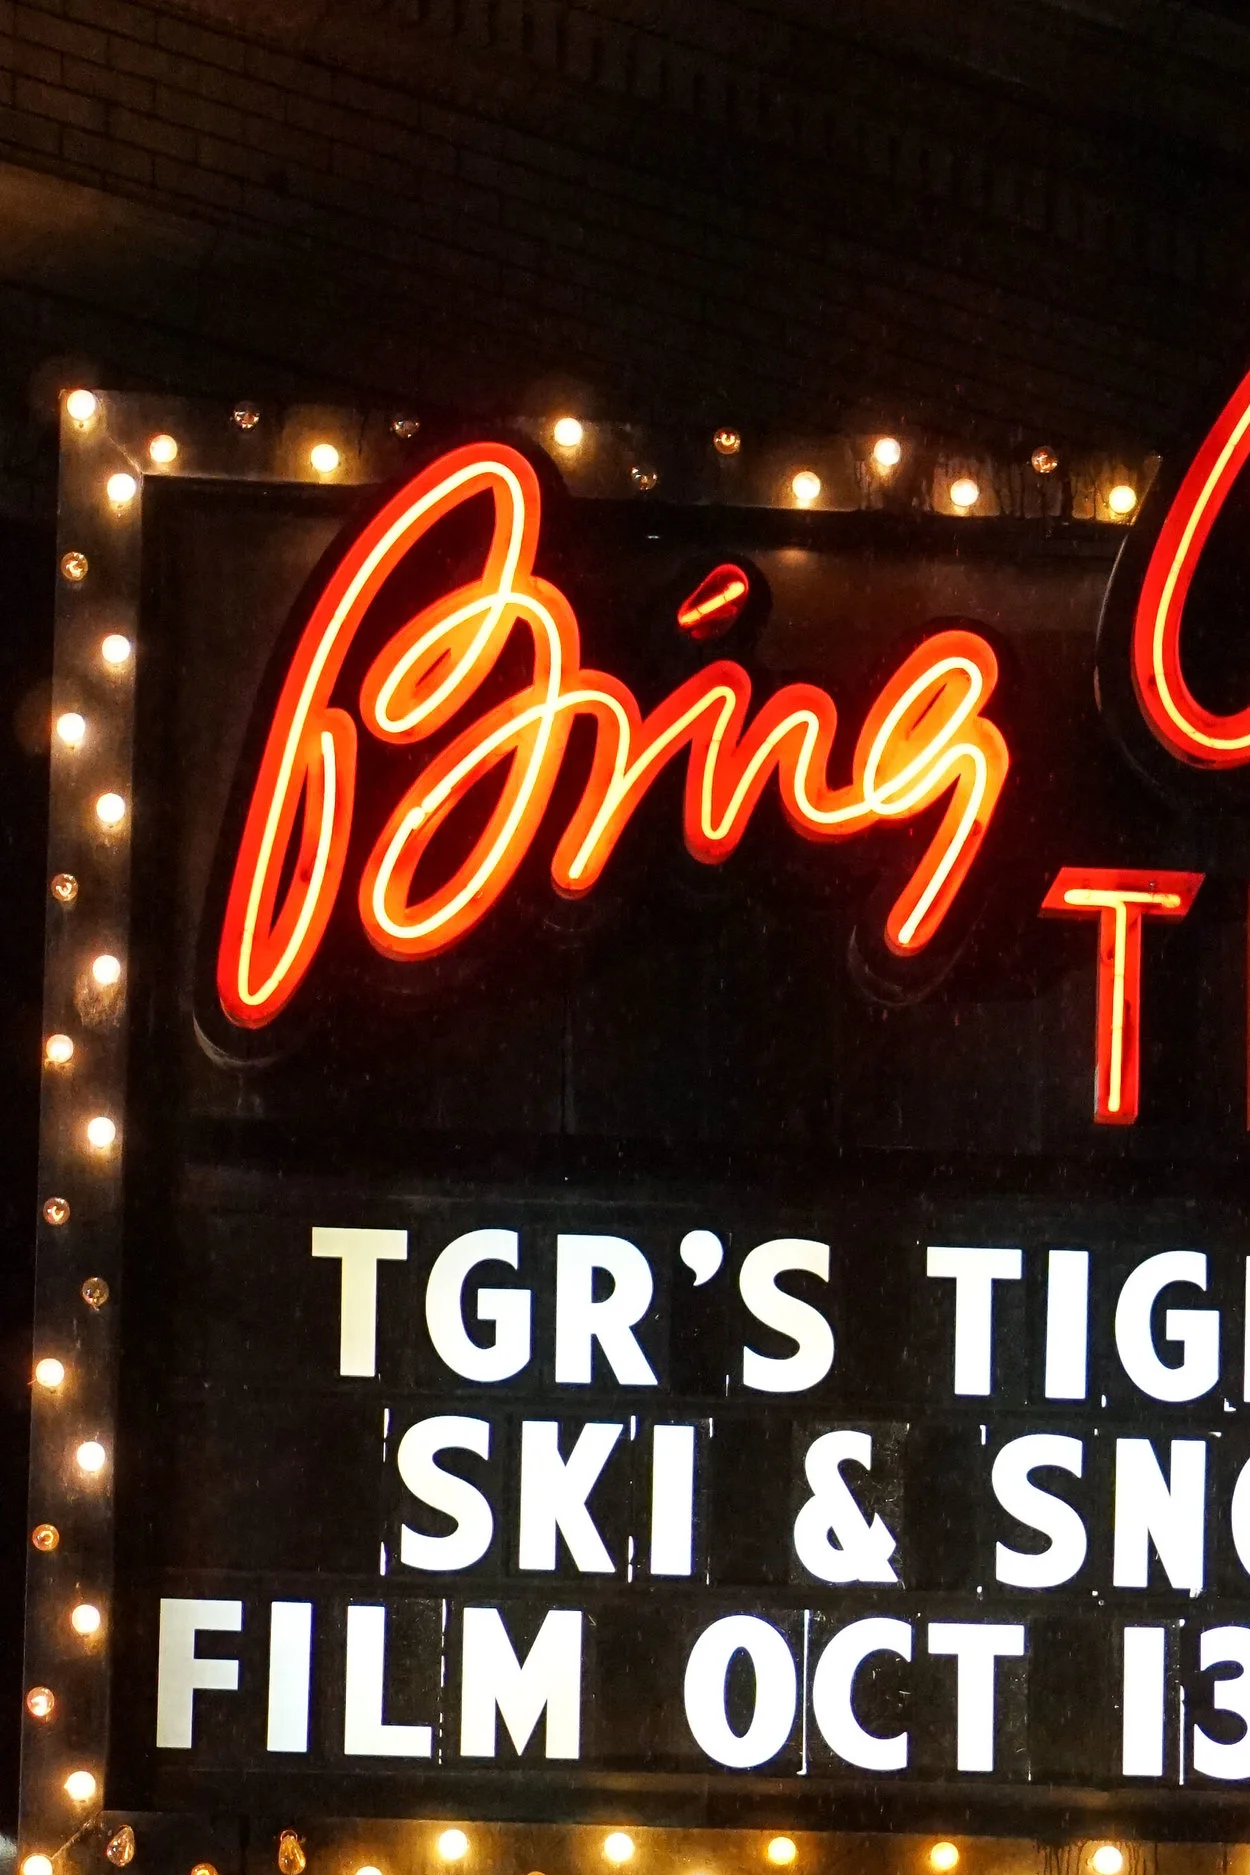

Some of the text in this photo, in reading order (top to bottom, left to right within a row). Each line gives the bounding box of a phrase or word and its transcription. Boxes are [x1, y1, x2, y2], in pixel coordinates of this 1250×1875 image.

[218, 442, 1008, 1028] Bing
[312, 1225, 836, 1394] TGR'S
[396, 1414, 694, 1576] SKI
[794, 1430, 899, 1586] &
[156, 1598, 582, 1761] FILM
[684, 1614, 1026, 1774] OCT
